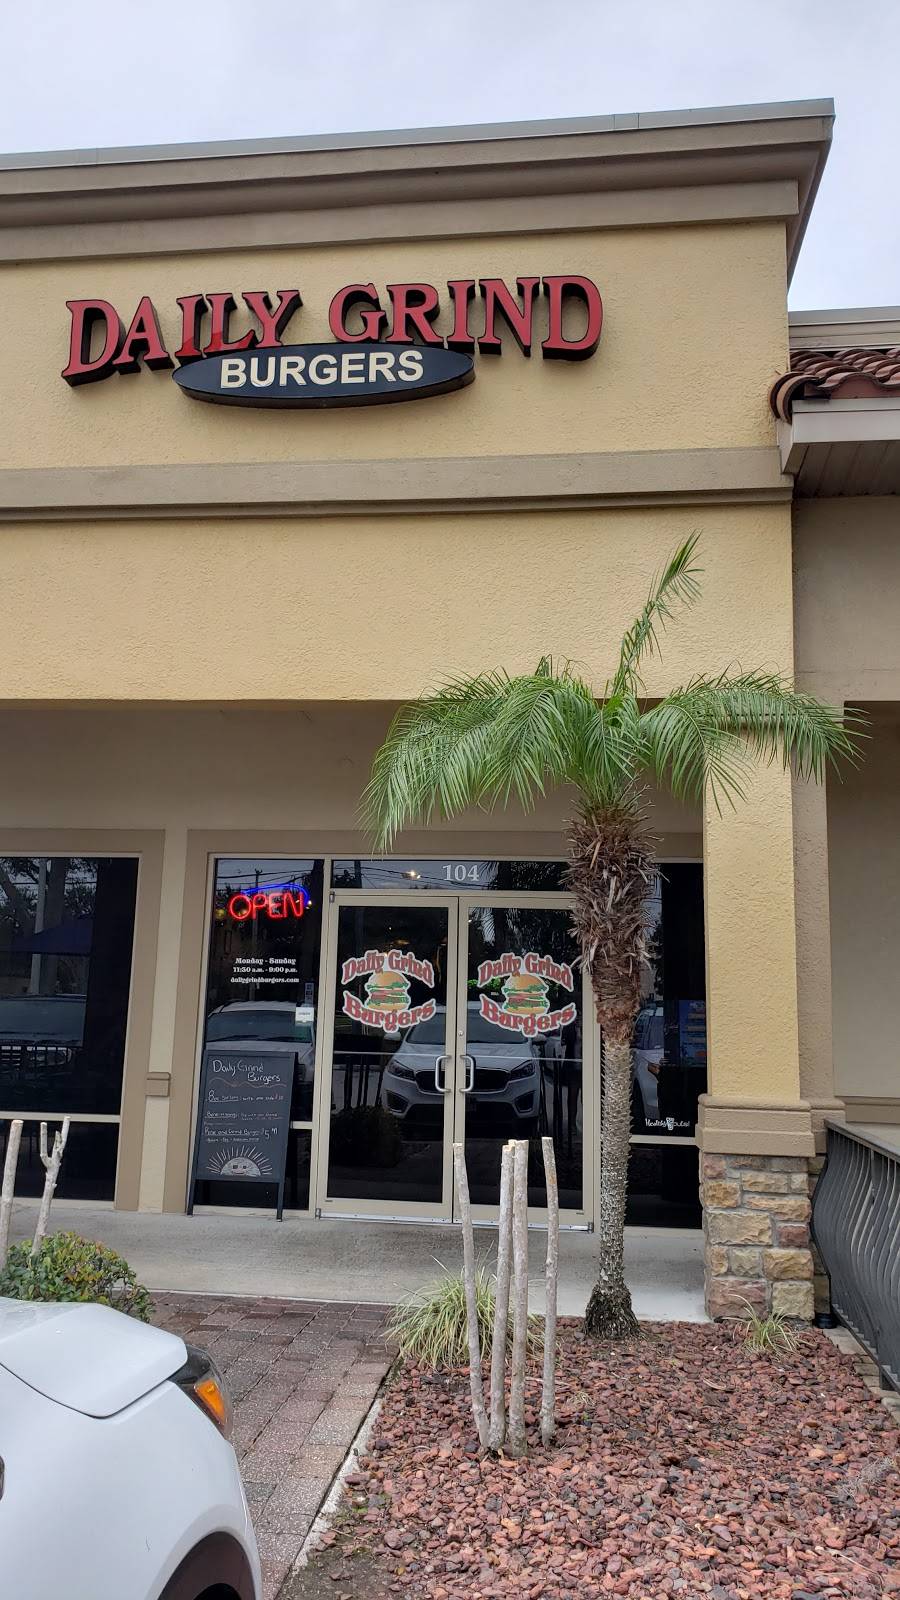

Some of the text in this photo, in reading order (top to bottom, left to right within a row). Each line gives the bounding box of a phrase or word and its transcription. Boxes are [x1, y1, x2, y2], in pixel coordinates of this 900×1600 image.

[61, 275, 603, 380] DAILY GRIND
[220, 350, 424, 389] BURGERS
[442, 864, 480, 881] 104
[229, 892, 305, 920] OPEN
[235, 957, 264, 965] Monday
[269, 957, 296, 965] Sunday
[342, 950, 435, 987] Daily Grind
[478, 953, 573, 991] Daily Grind
[343, 991, 435, 1032] Burgers
[480, 995, 577, 1036] Burgers
[212, 1059, 236, 1077] Daily
[247, 1071, 281, 1085] Burgers
